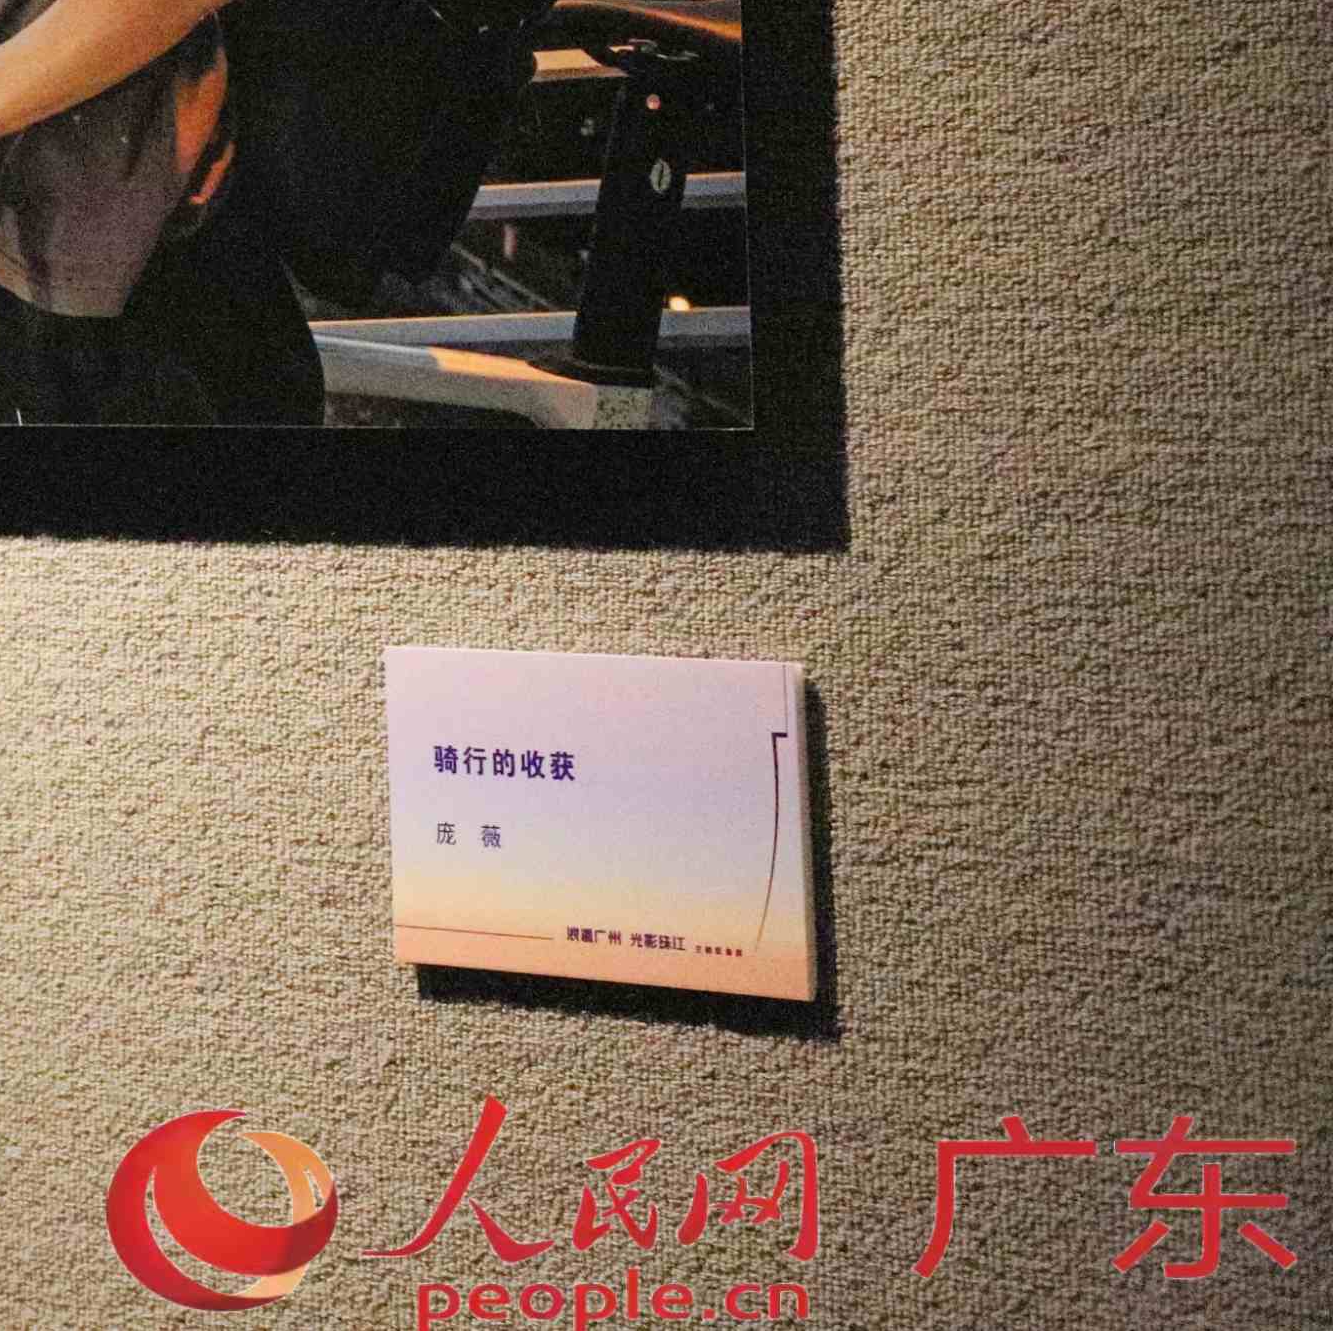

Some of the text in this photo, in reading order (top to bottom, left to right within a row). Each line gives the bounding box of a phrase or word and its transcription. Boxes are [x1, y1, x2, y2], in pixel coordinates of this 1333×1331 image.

[433, 744, 576, 781] 骑行的收获
[436, 822, 457, 846] 庞
